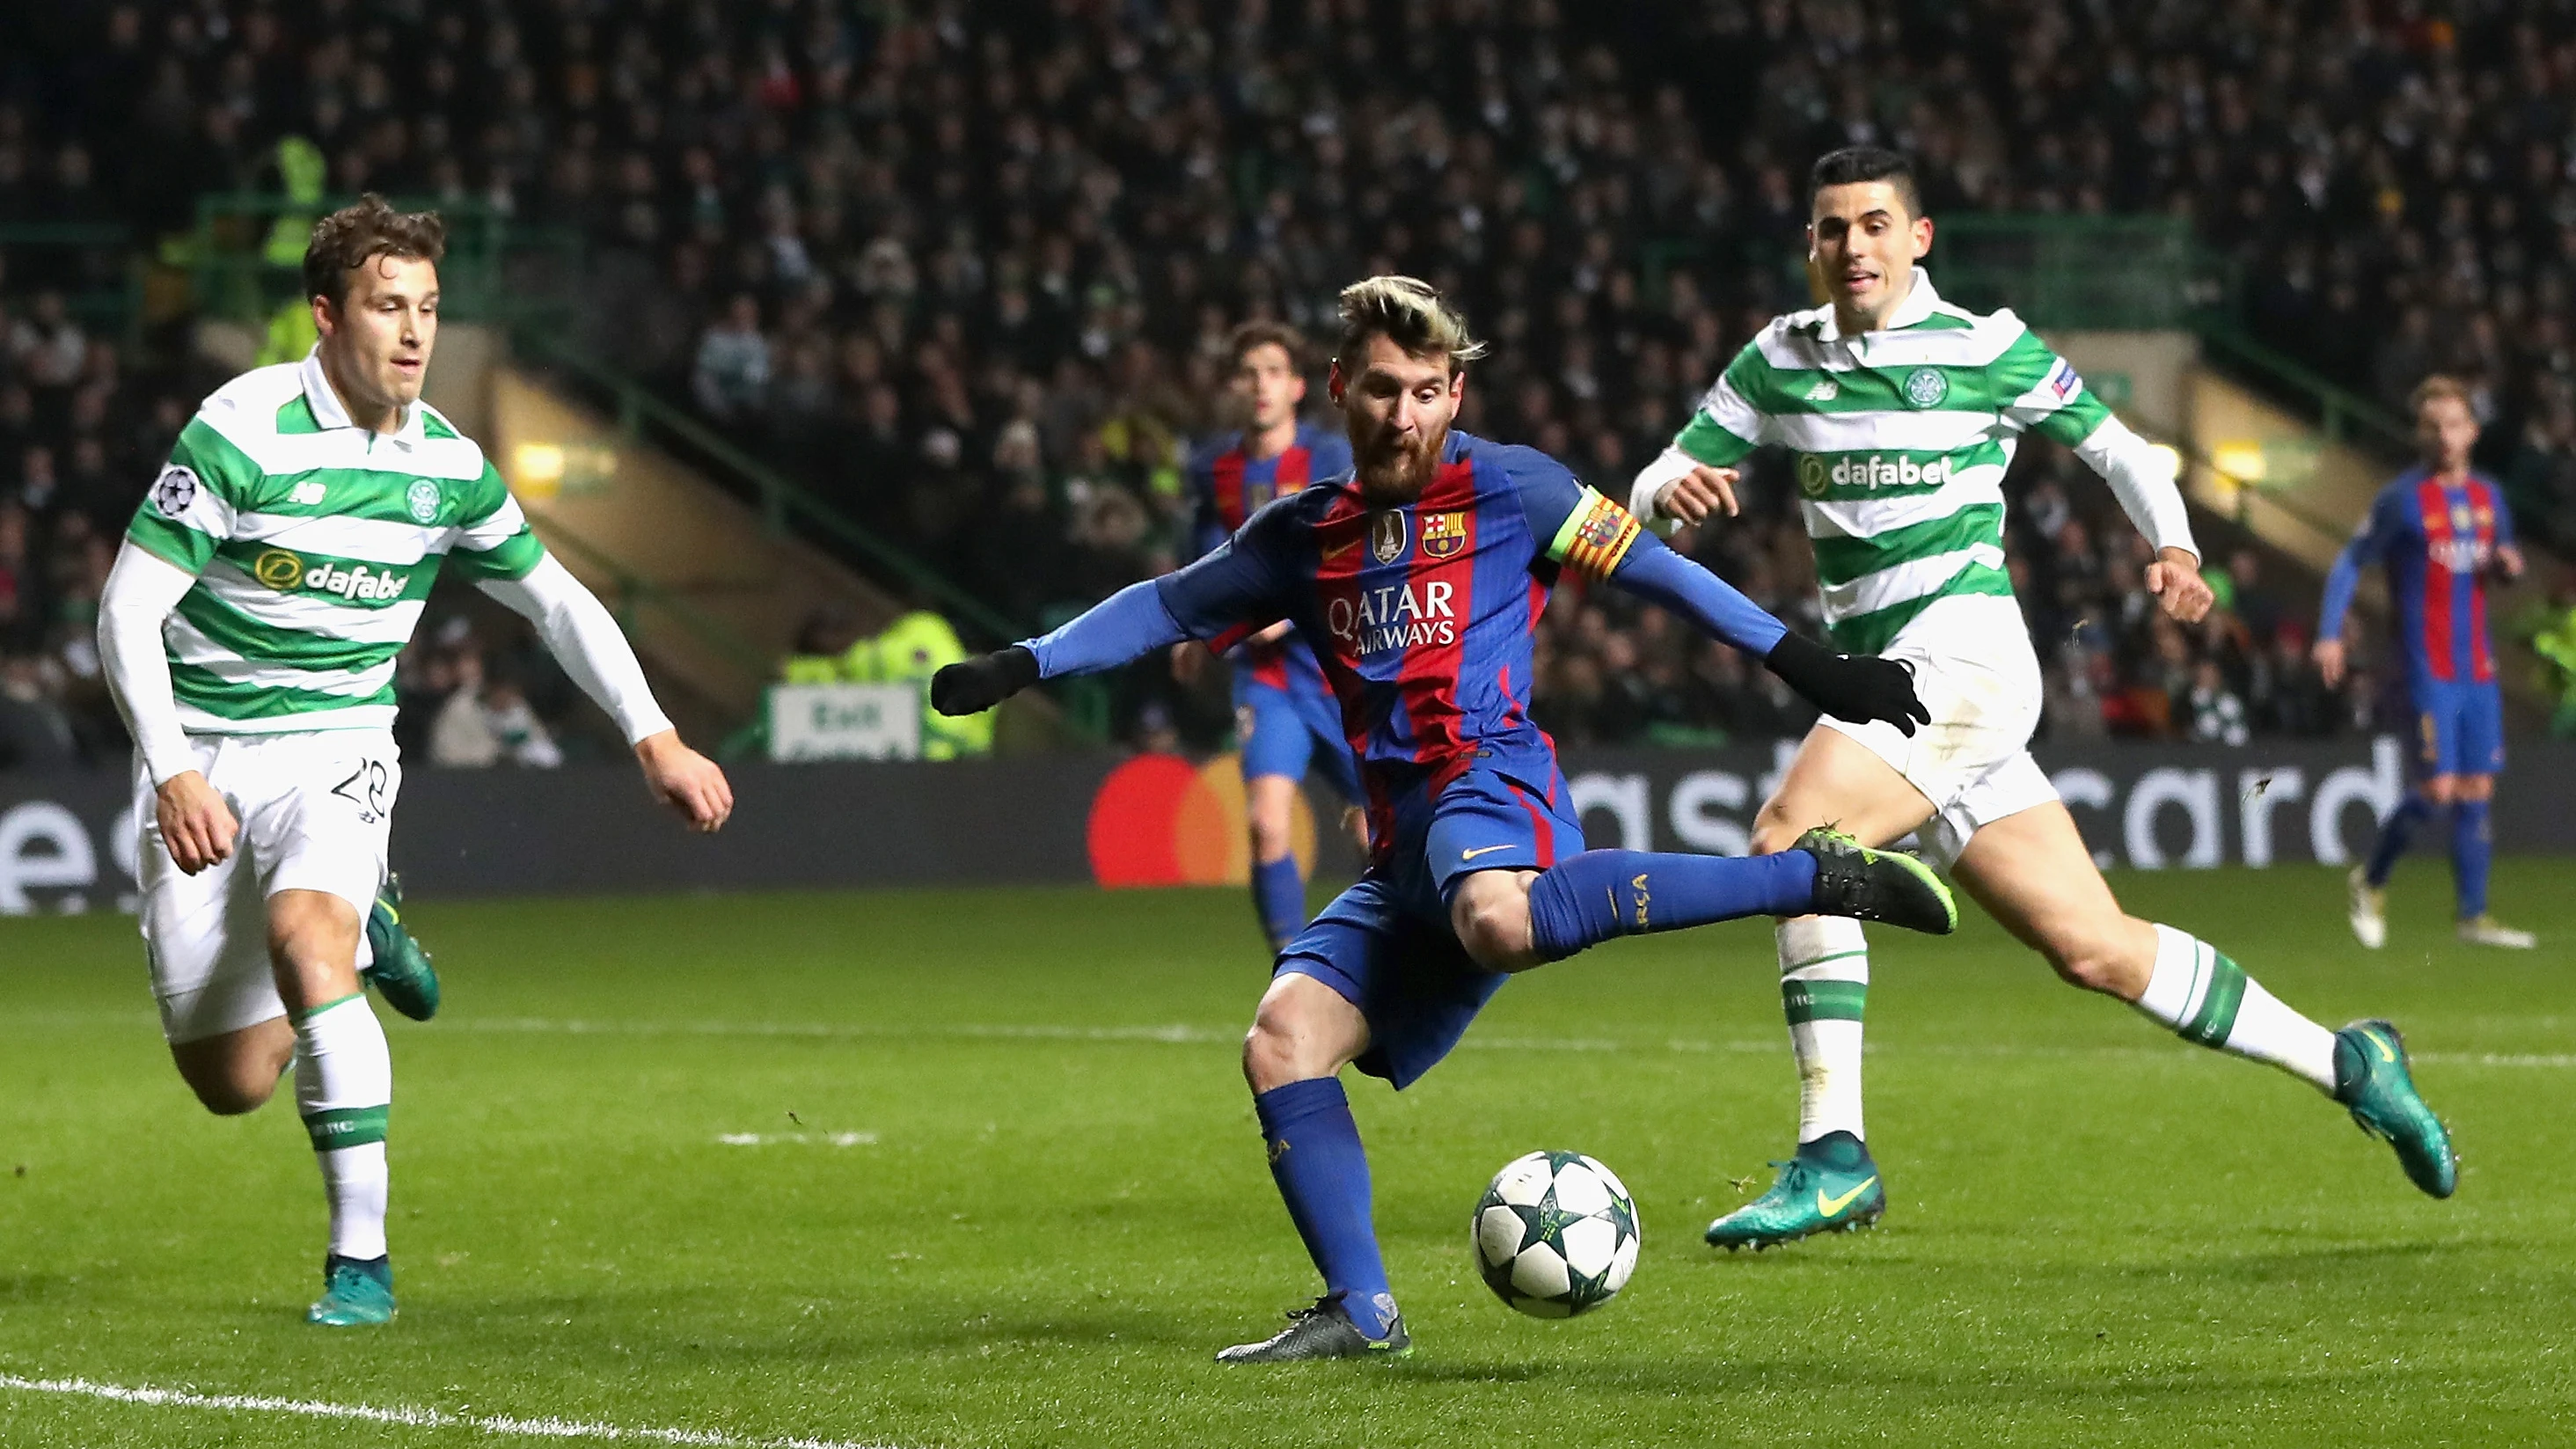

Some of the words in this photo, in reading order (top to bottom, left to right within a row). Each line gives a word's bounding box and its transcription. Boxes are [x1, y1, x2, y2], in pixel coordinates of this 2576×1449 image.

[1832, 455, 1952, 490] dafabet
[305, 562, 409, 600] dafabe
[1328, 581, 1455, 640] QATAR
[1352, 619, 1455, 657] AIRWAYS
